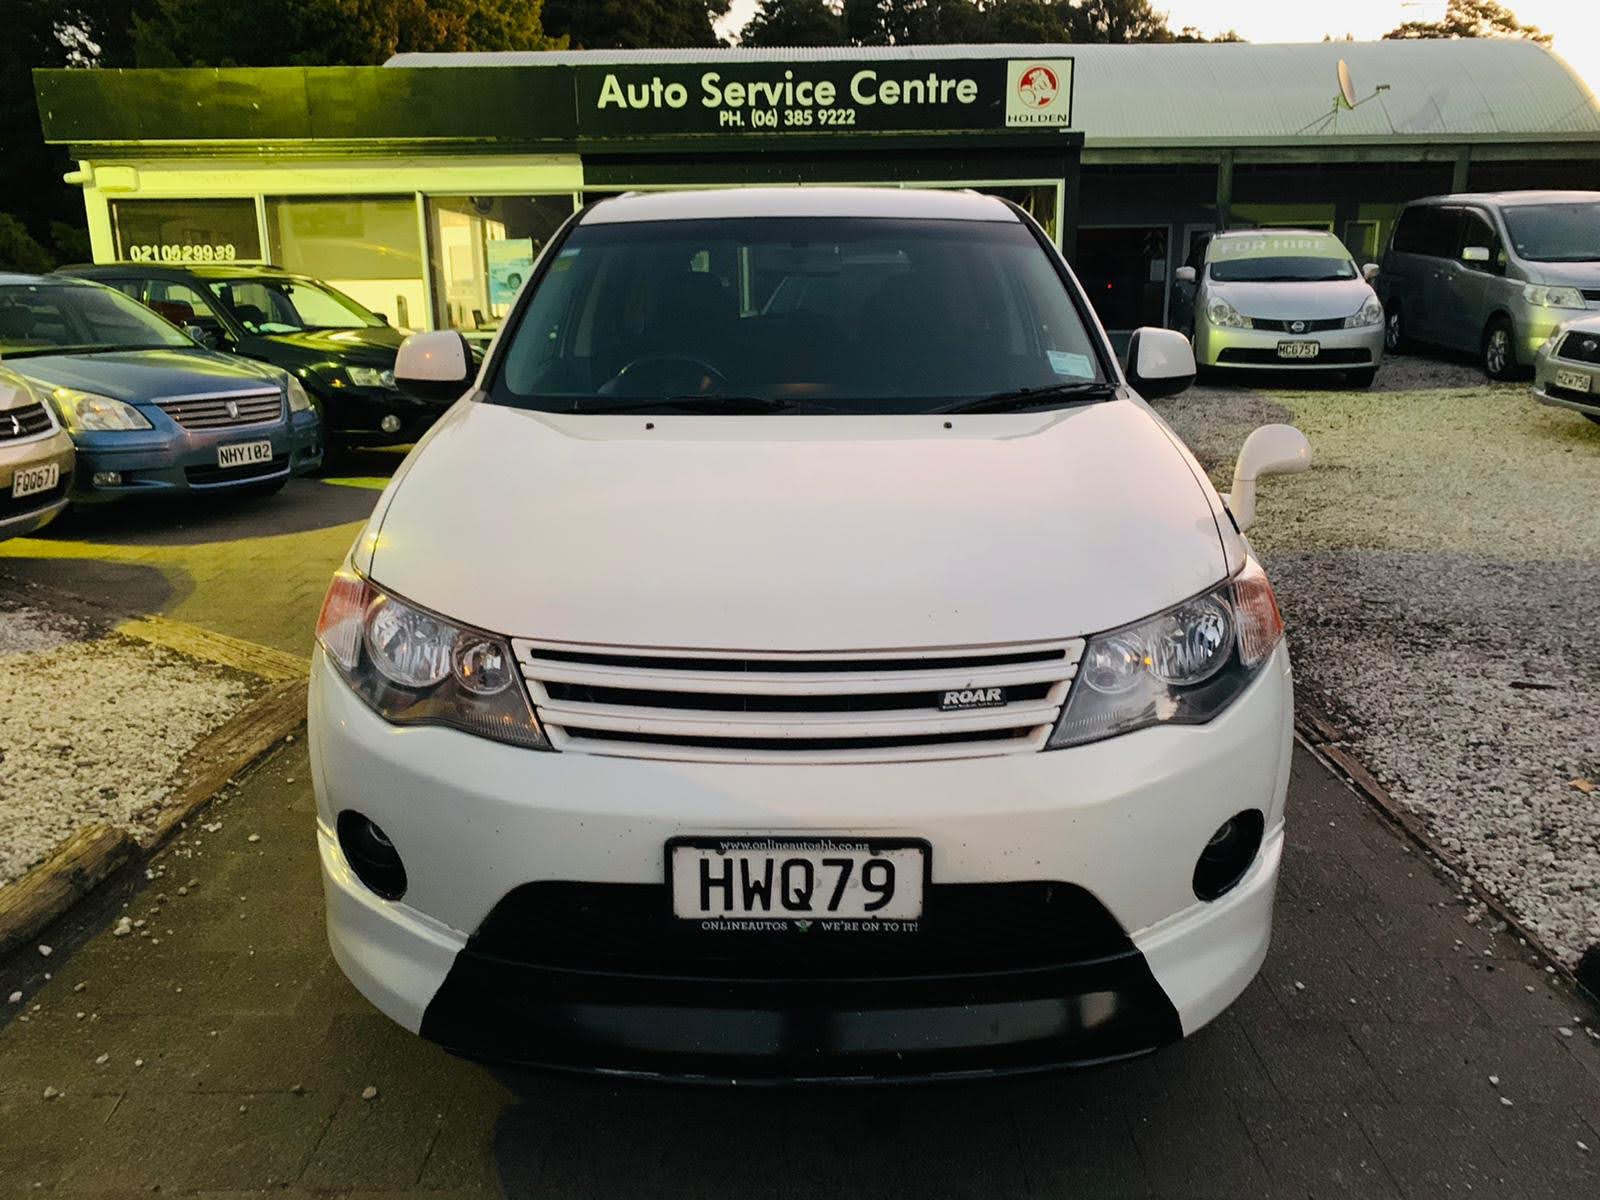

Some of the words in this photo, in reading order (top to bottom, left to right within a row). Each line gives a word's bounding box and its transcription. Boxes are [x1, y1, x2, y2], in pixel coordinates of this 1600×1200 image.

[597, 74, 688, 109] Auto
[701, 70, 836, 108] Service
[850, 69, 978, 105] Centre
[719, 110, 745, 127] PH.
[751, 108, 778, 128] (06)
[784, 109, 813, 126] 385
[817, 108, 856, 126] 9222
[1007, 114, 1067, 123] HOLDEN
[1221, 240, 1267, 253] FOR
[1273, 239, 1327, 251] HIRE
[1279, 344, 1317, 355] MCG751
[220, 444, 270, 464] NHY102
[943, 688, 1002, 705] ROAR
[720, 839, 869, 851] www.onlineautoshb.co.nz
[700, 858, 895, 911] HWQ79
[701, 920, 788, 931] ONLINEAUTOS
[821, 921, 859, 932] WE'RE
[862, 921, 880, 932] ON
[882, 921, 900, 932] TO
[902, 921, 919, 932] IT!
